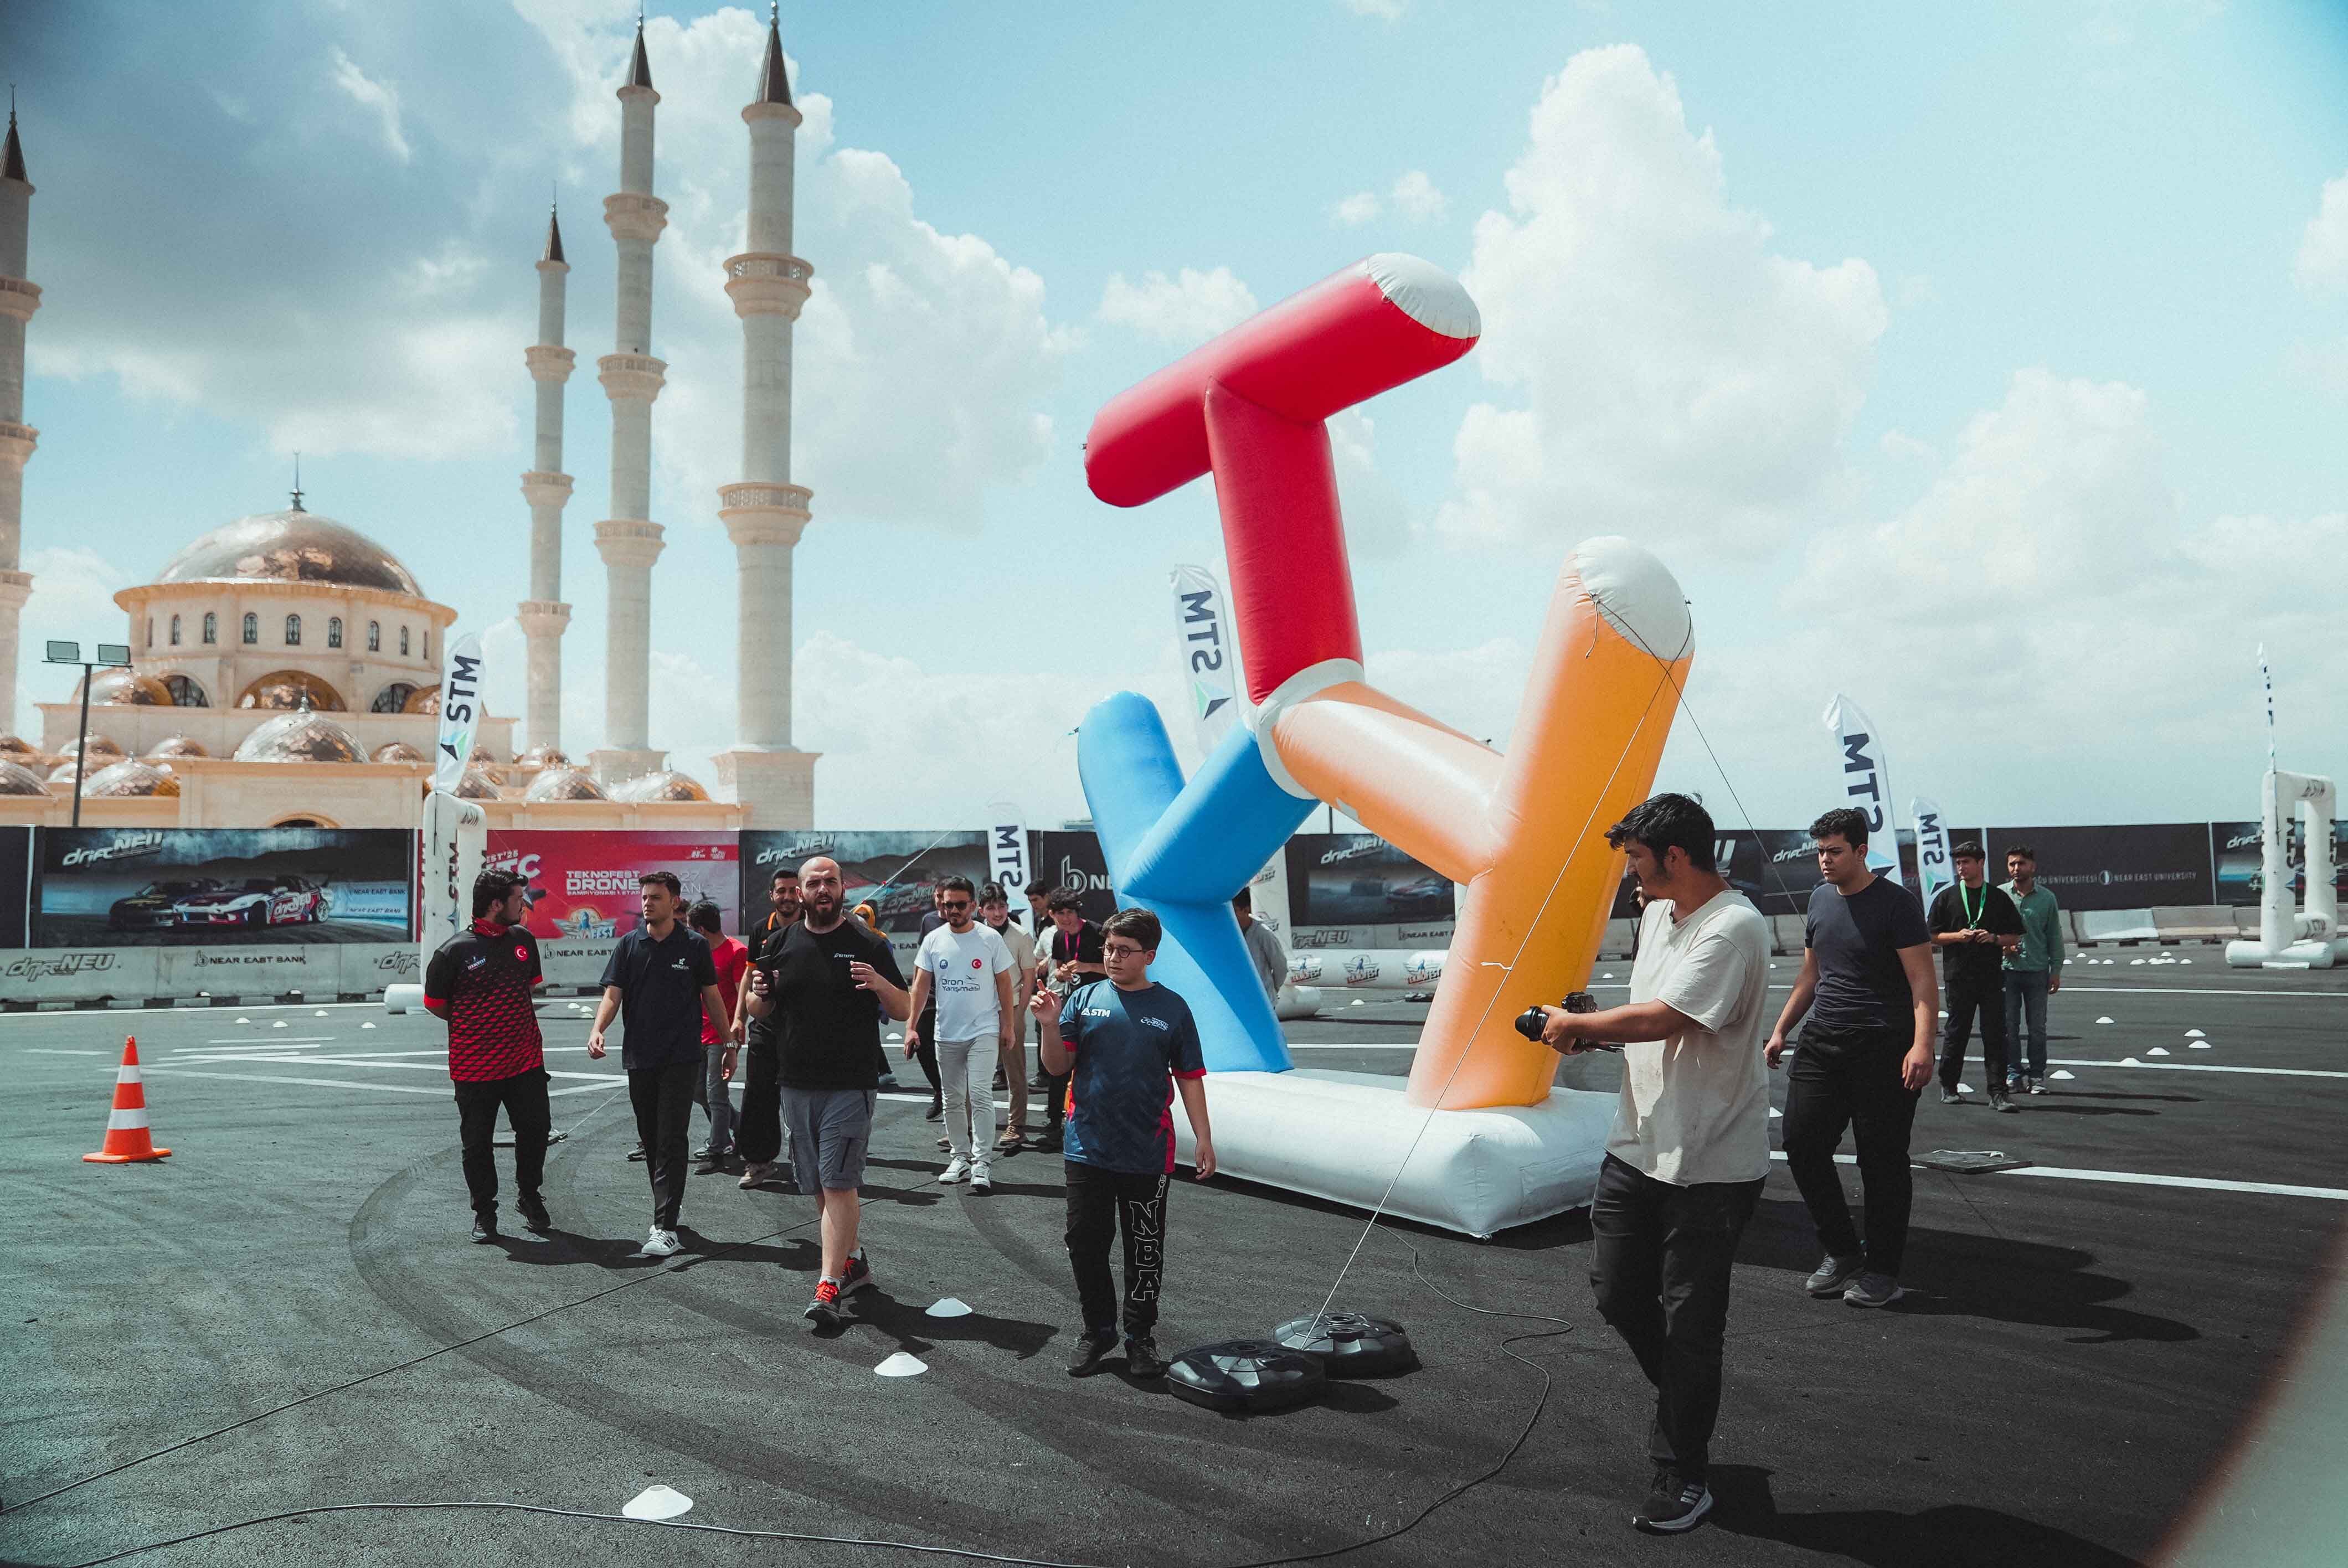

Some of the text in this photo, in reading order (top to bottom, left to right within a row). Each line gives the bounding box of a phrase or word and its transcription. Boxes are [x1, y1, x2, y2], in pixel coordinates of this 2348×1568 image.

[446, 655, 481, 724] STM
[567, 870, 641, 879] TEKNOFEST
[567, 879, 641, 890] DRONE
[276, 956, 306, 964] BANK
[1090, 1008, 1111, 1018] STM
[1129, 1199, 1161, 1301] NBA
